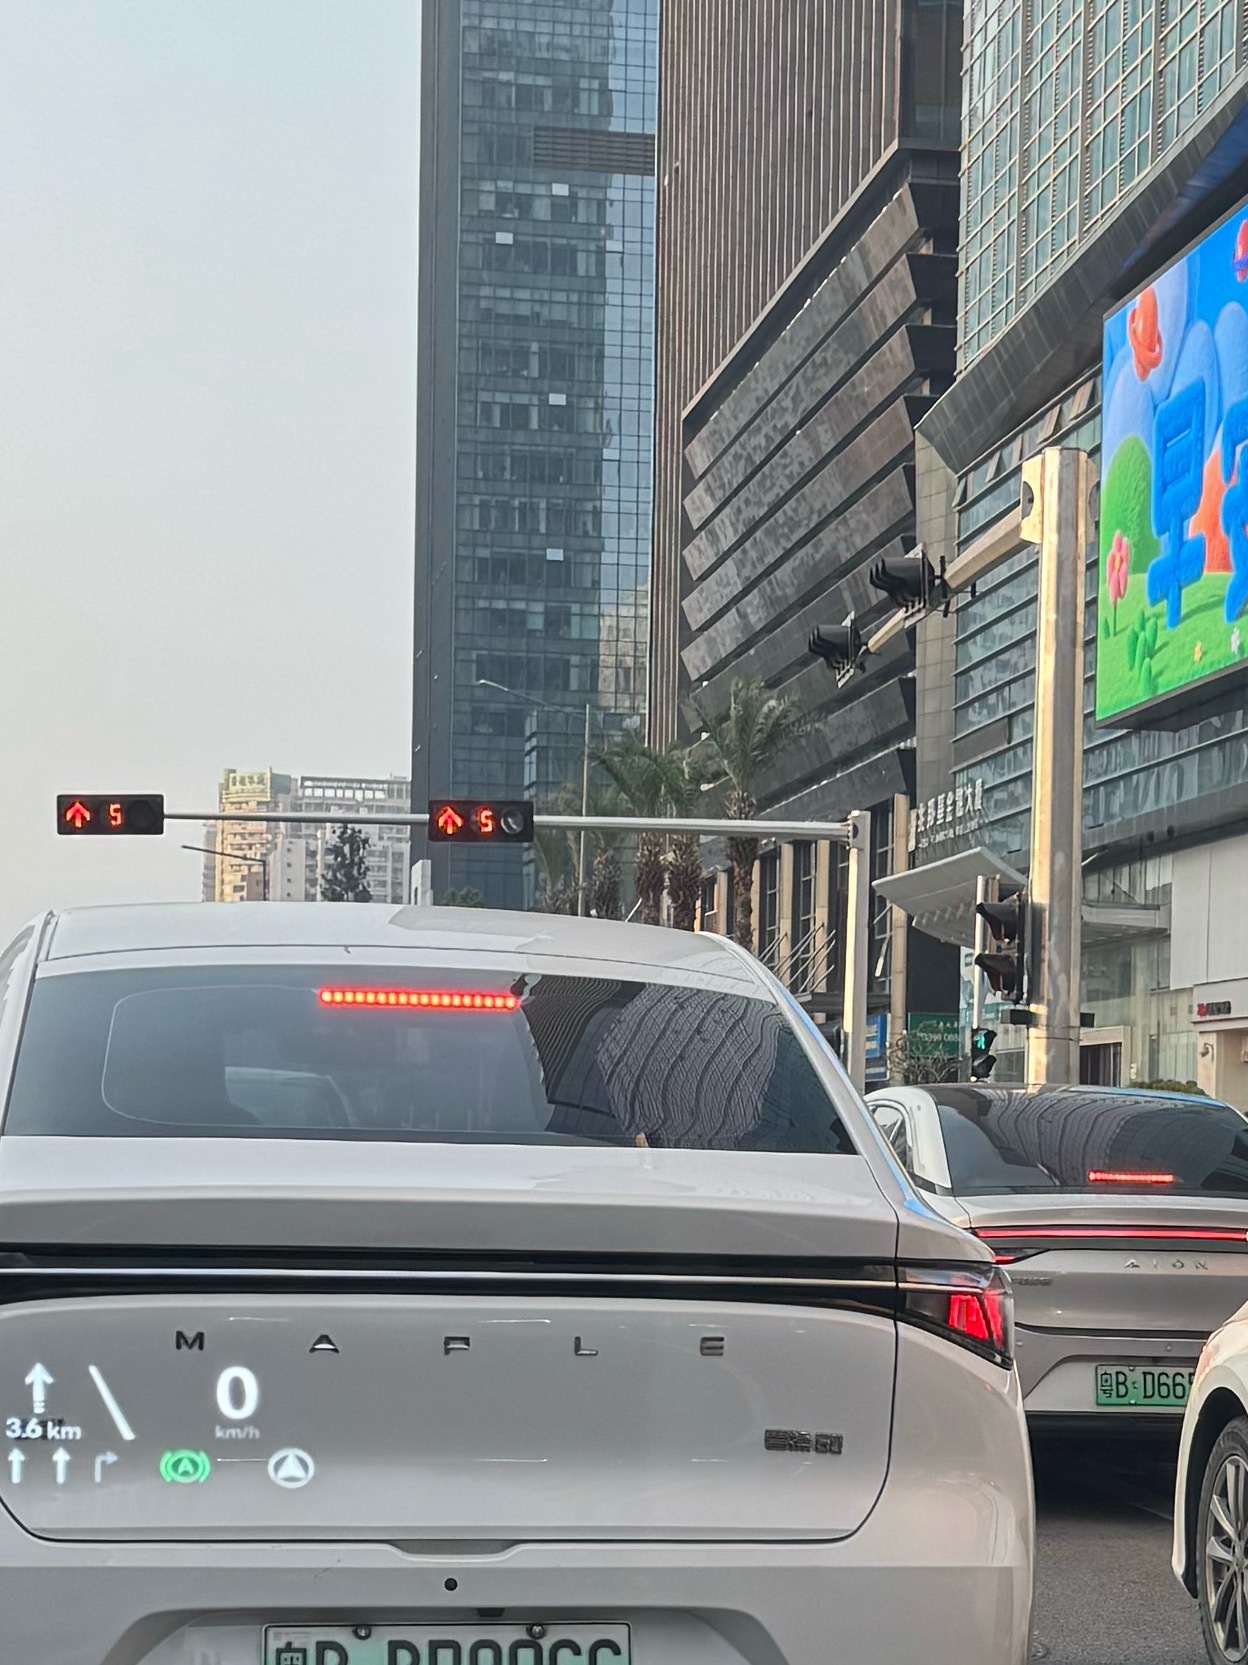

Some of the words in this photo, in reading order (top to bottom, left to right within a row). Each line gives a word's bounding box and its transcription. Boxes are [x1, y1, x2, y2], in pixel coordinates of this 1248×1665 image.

[109, 803, 122, 826] 5
[479, 807, 494, 832] 5
[1123, 1257, 1209, 1271] AION
[175, 1330, 725, 1357] MAPLE
[216, 1366, 259, 1420] 0
[5, 1417, 43, 1440] 3.6
[46, 1420, 82, 1440] km
[214, 1425, 260, 1440] km/h
